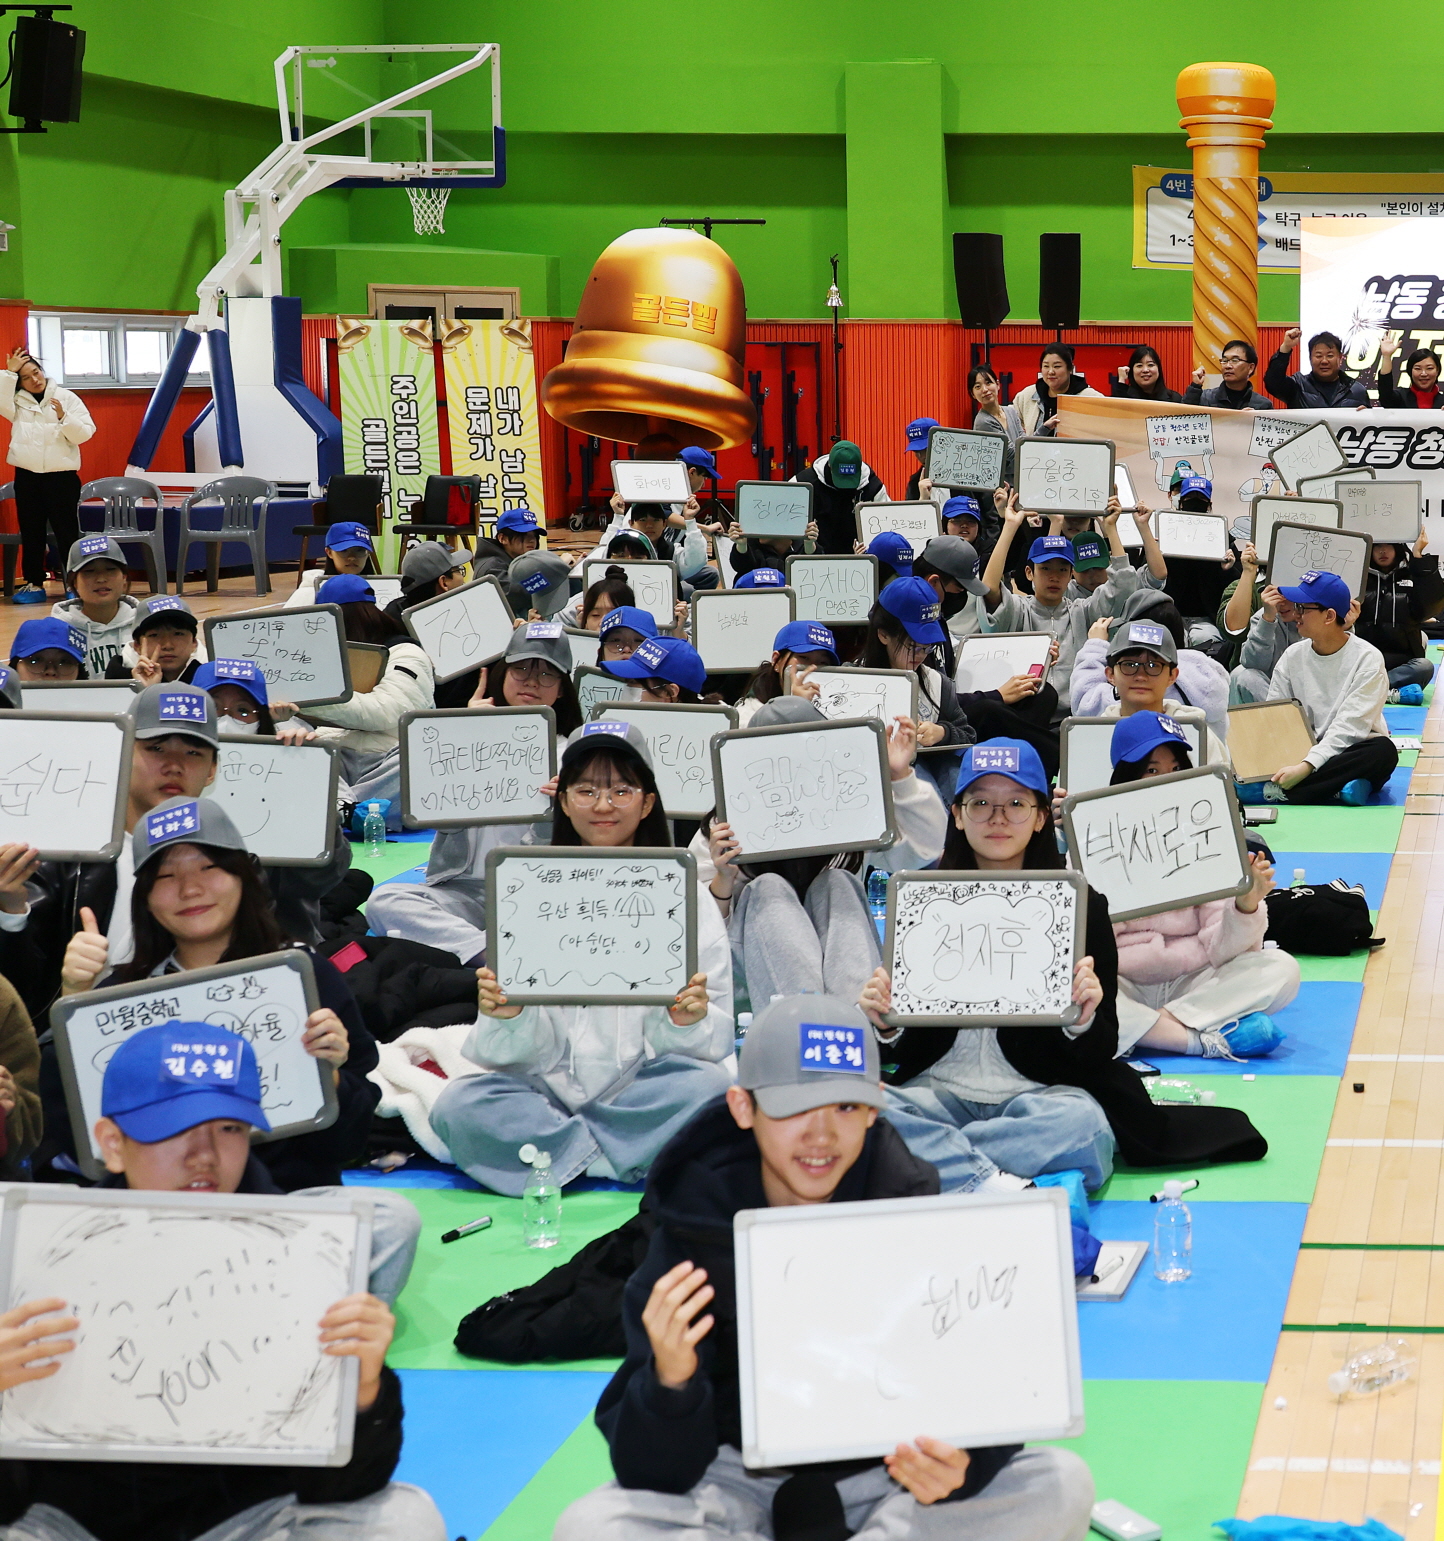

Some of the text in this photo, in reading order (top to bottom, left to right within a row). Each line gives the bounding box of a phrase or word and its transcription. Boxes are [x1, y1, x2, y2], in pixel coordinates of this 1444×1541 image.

[631, 292, 718, 335] 골든벨
[391, 375, 422, 475] 주인공은
[465, 386, 495, 461] 문제가
[495, 386, 523, 436] 내가
[1170, 423, 1190, 433] 청소년
[1174, 433, 1211, 446] 안전골든벨
[1338, 427, 1412, 468] 남동
[634, 474, 672, 491] 화이팅
[1022, 456, 1080, 483] 구월중
[1043, 486, 1105, 509] 이지후
[798, 566, 871, 601] 김채이
[974, 756, 1015, 769] 정지후
[1084, 798, 1223, 886] 박새로운
[537, 900, 571, 921] 우산
[932, 915, 1032, 983] 정지후
